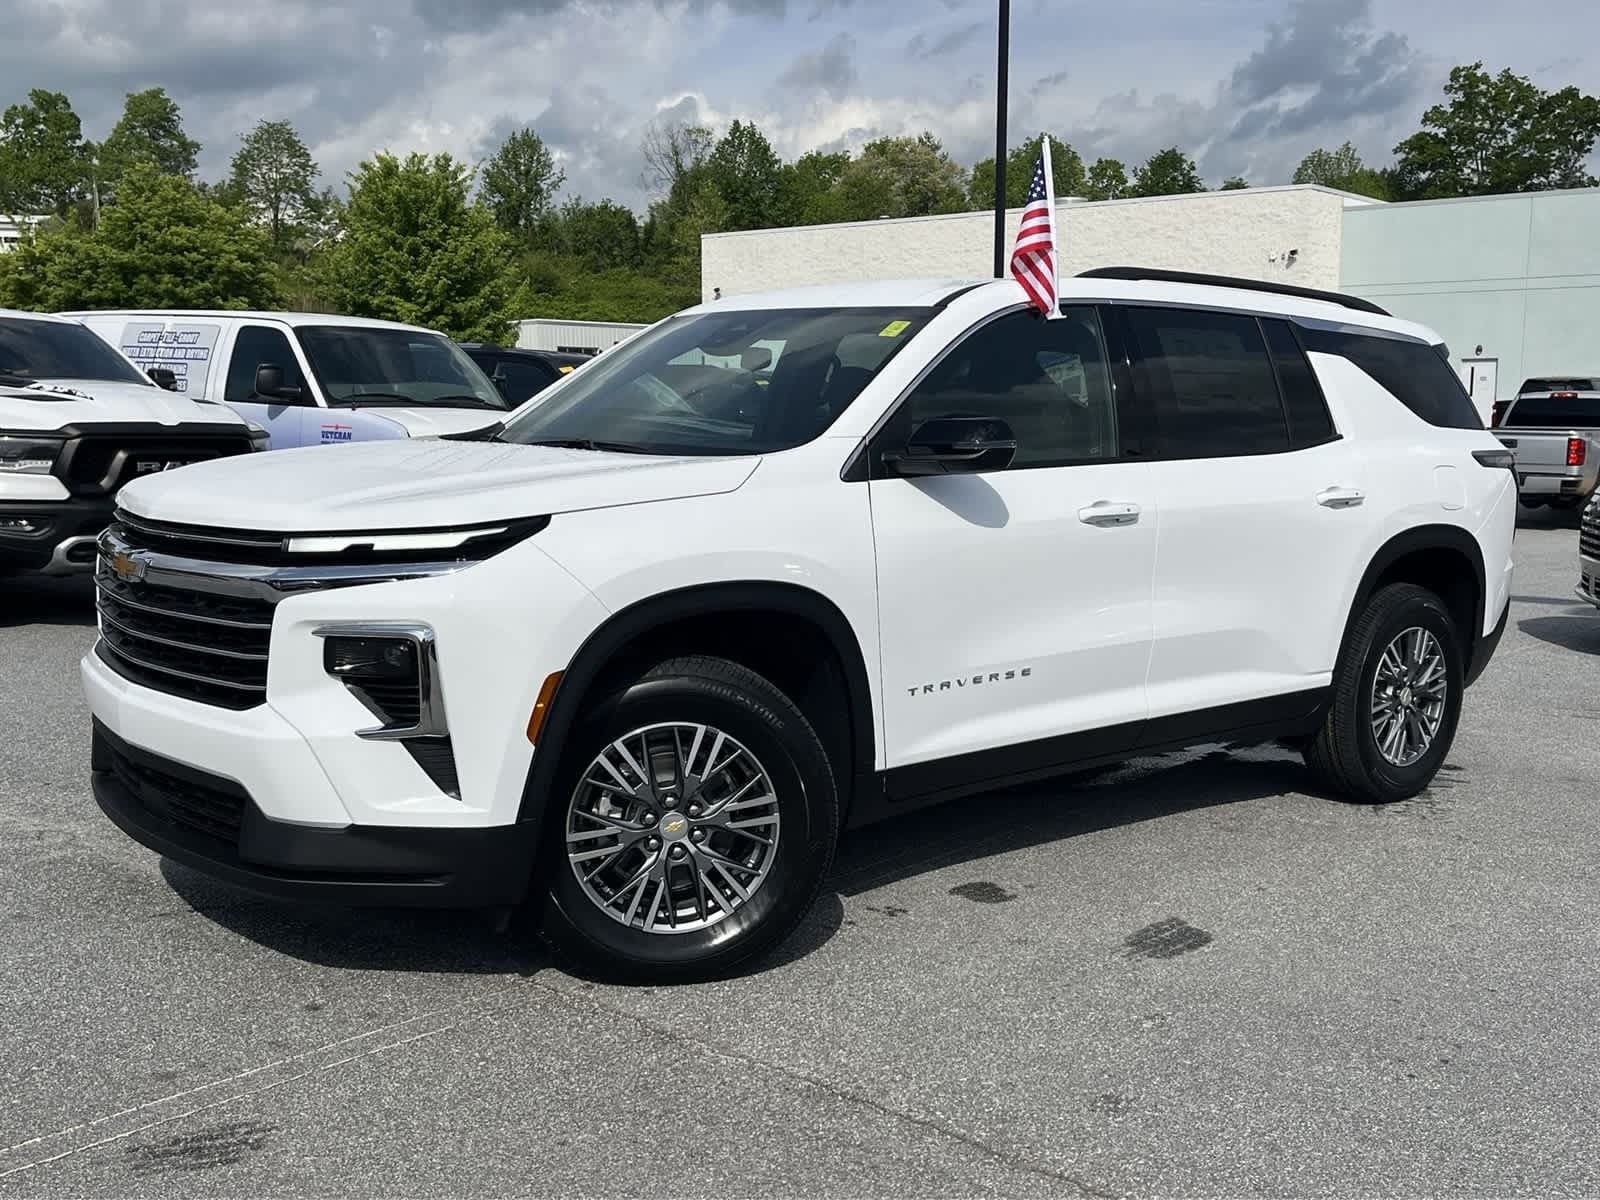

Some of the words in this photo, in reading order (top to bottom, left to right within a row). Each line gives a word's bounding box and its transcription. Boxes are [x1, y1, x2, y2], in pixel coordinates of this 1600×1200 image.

[321, 430, 352, 440] VETERAN
[137, 461, 194, 472] RA
[907, 667, 1031, 697] TRAVERSE
